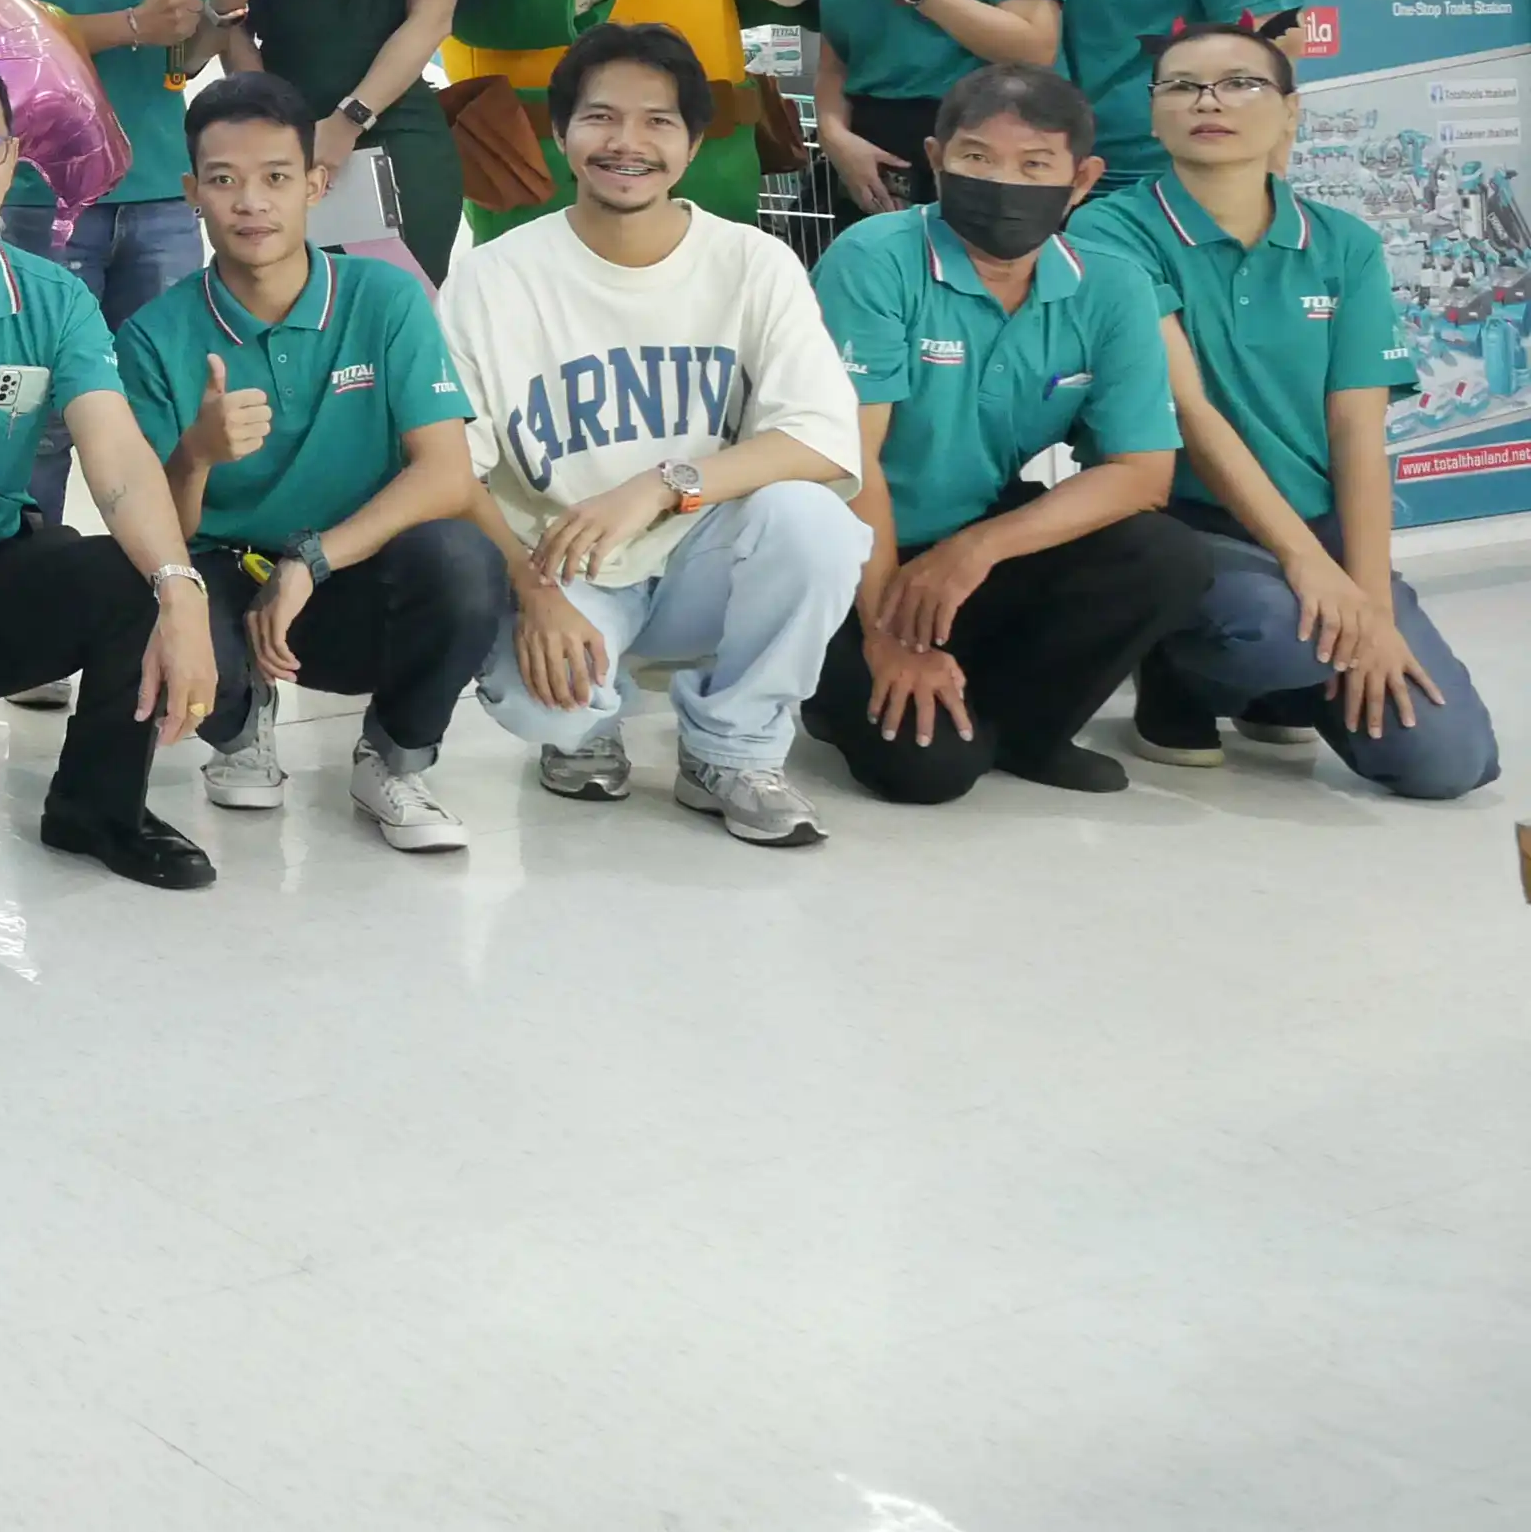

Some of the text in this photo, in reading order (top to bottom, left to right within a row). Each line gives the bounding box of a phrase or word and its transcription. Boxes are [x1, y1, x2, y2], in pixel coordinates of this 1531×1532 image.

[1393, 0, 1513, 17] One-Stop Tools Station
[920, 338, 964, 353] TOTAL
[332, 364, 374, 384] TOTAL
[1402, 448, 1531, 475] www.totalthailand.net
